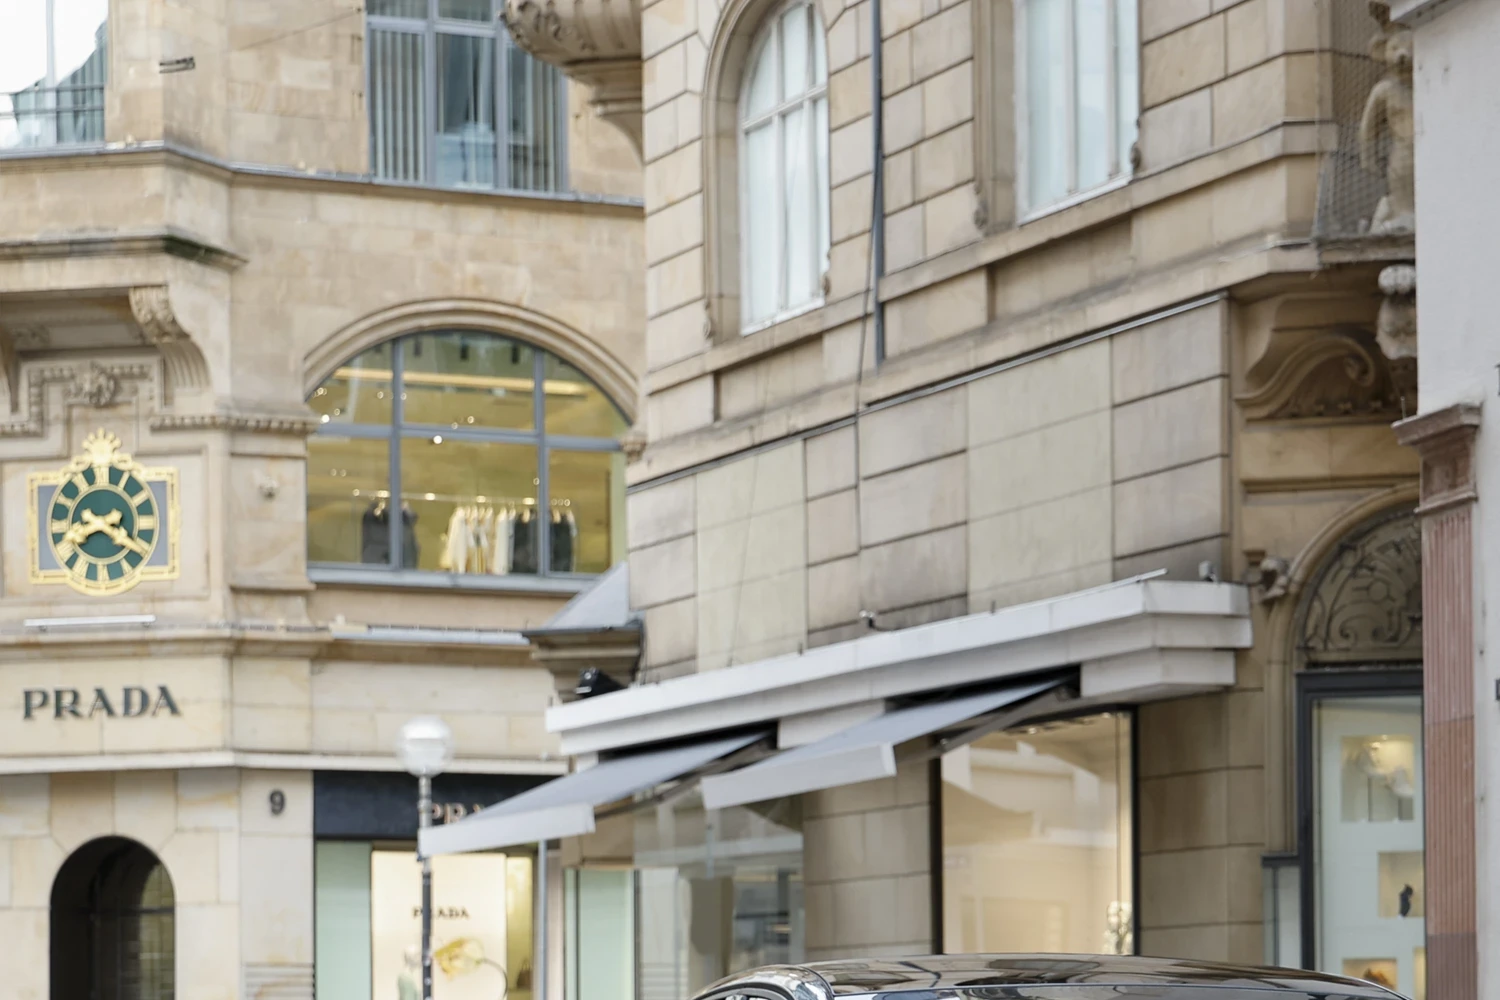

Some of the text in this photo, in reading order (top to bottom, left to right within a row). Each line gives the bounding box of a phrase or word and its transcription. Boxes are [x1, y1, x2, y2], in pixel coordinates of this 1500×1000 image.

[23, 685, 182, 719] PRADA
[269, 789, 286, 816] 9
[412, 905, 471, 920] PADA
